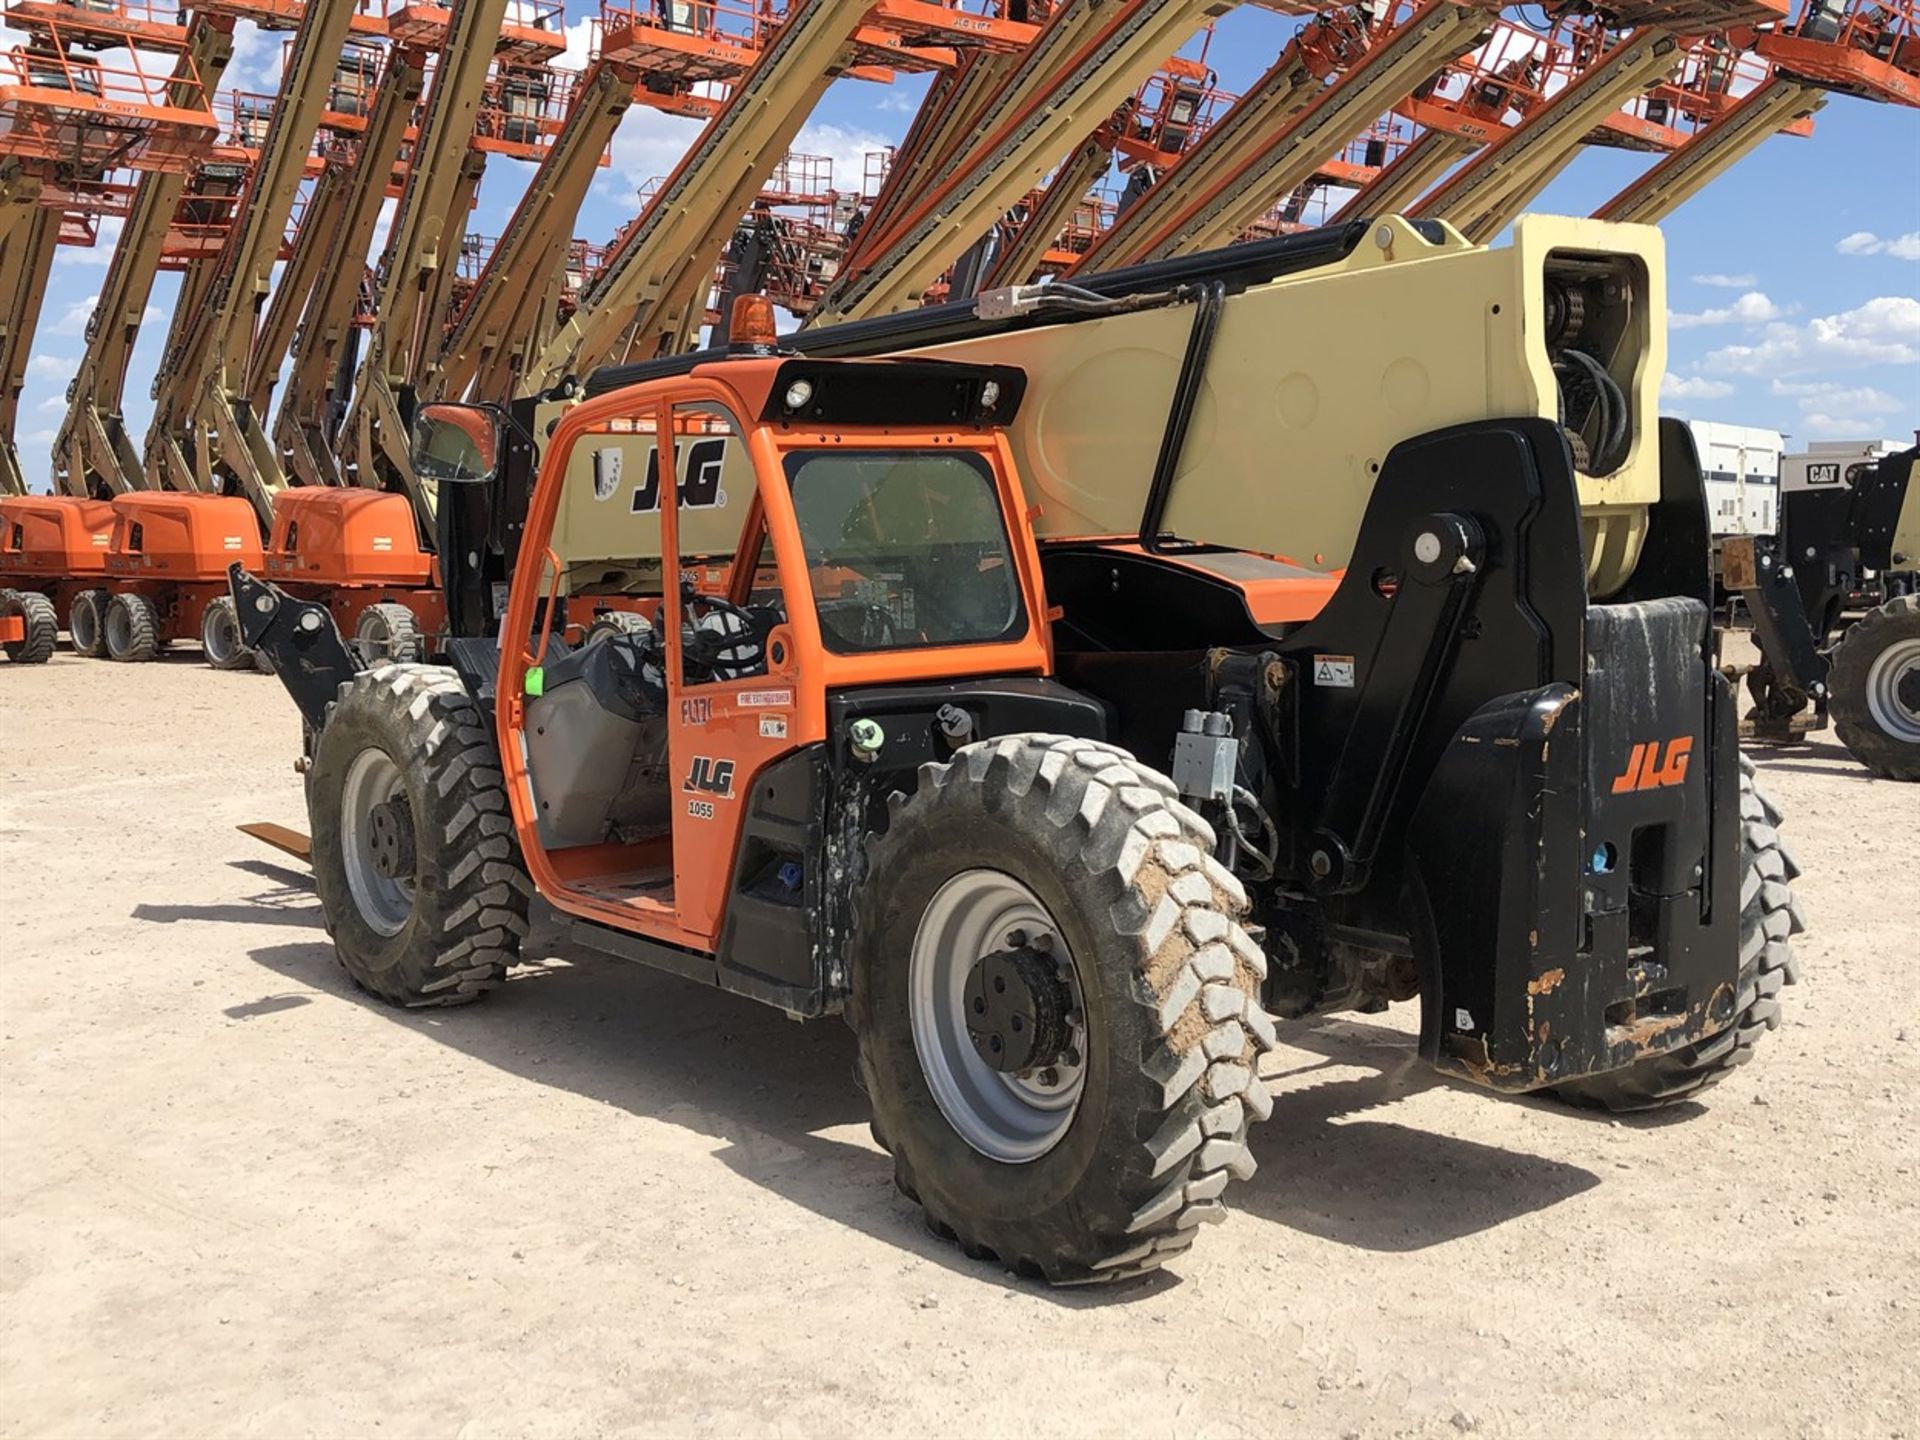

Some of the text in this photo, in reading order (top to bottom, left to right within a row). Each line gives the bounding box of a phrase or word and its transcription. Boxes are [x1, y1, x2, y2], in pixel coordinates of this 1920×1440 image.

[1809, 464, 1837, 482] CAT
[682, 756, 735, 797] JLG
[1611, 735, 1694, 795] JLG
[688, 801, 713, 819] 1055
